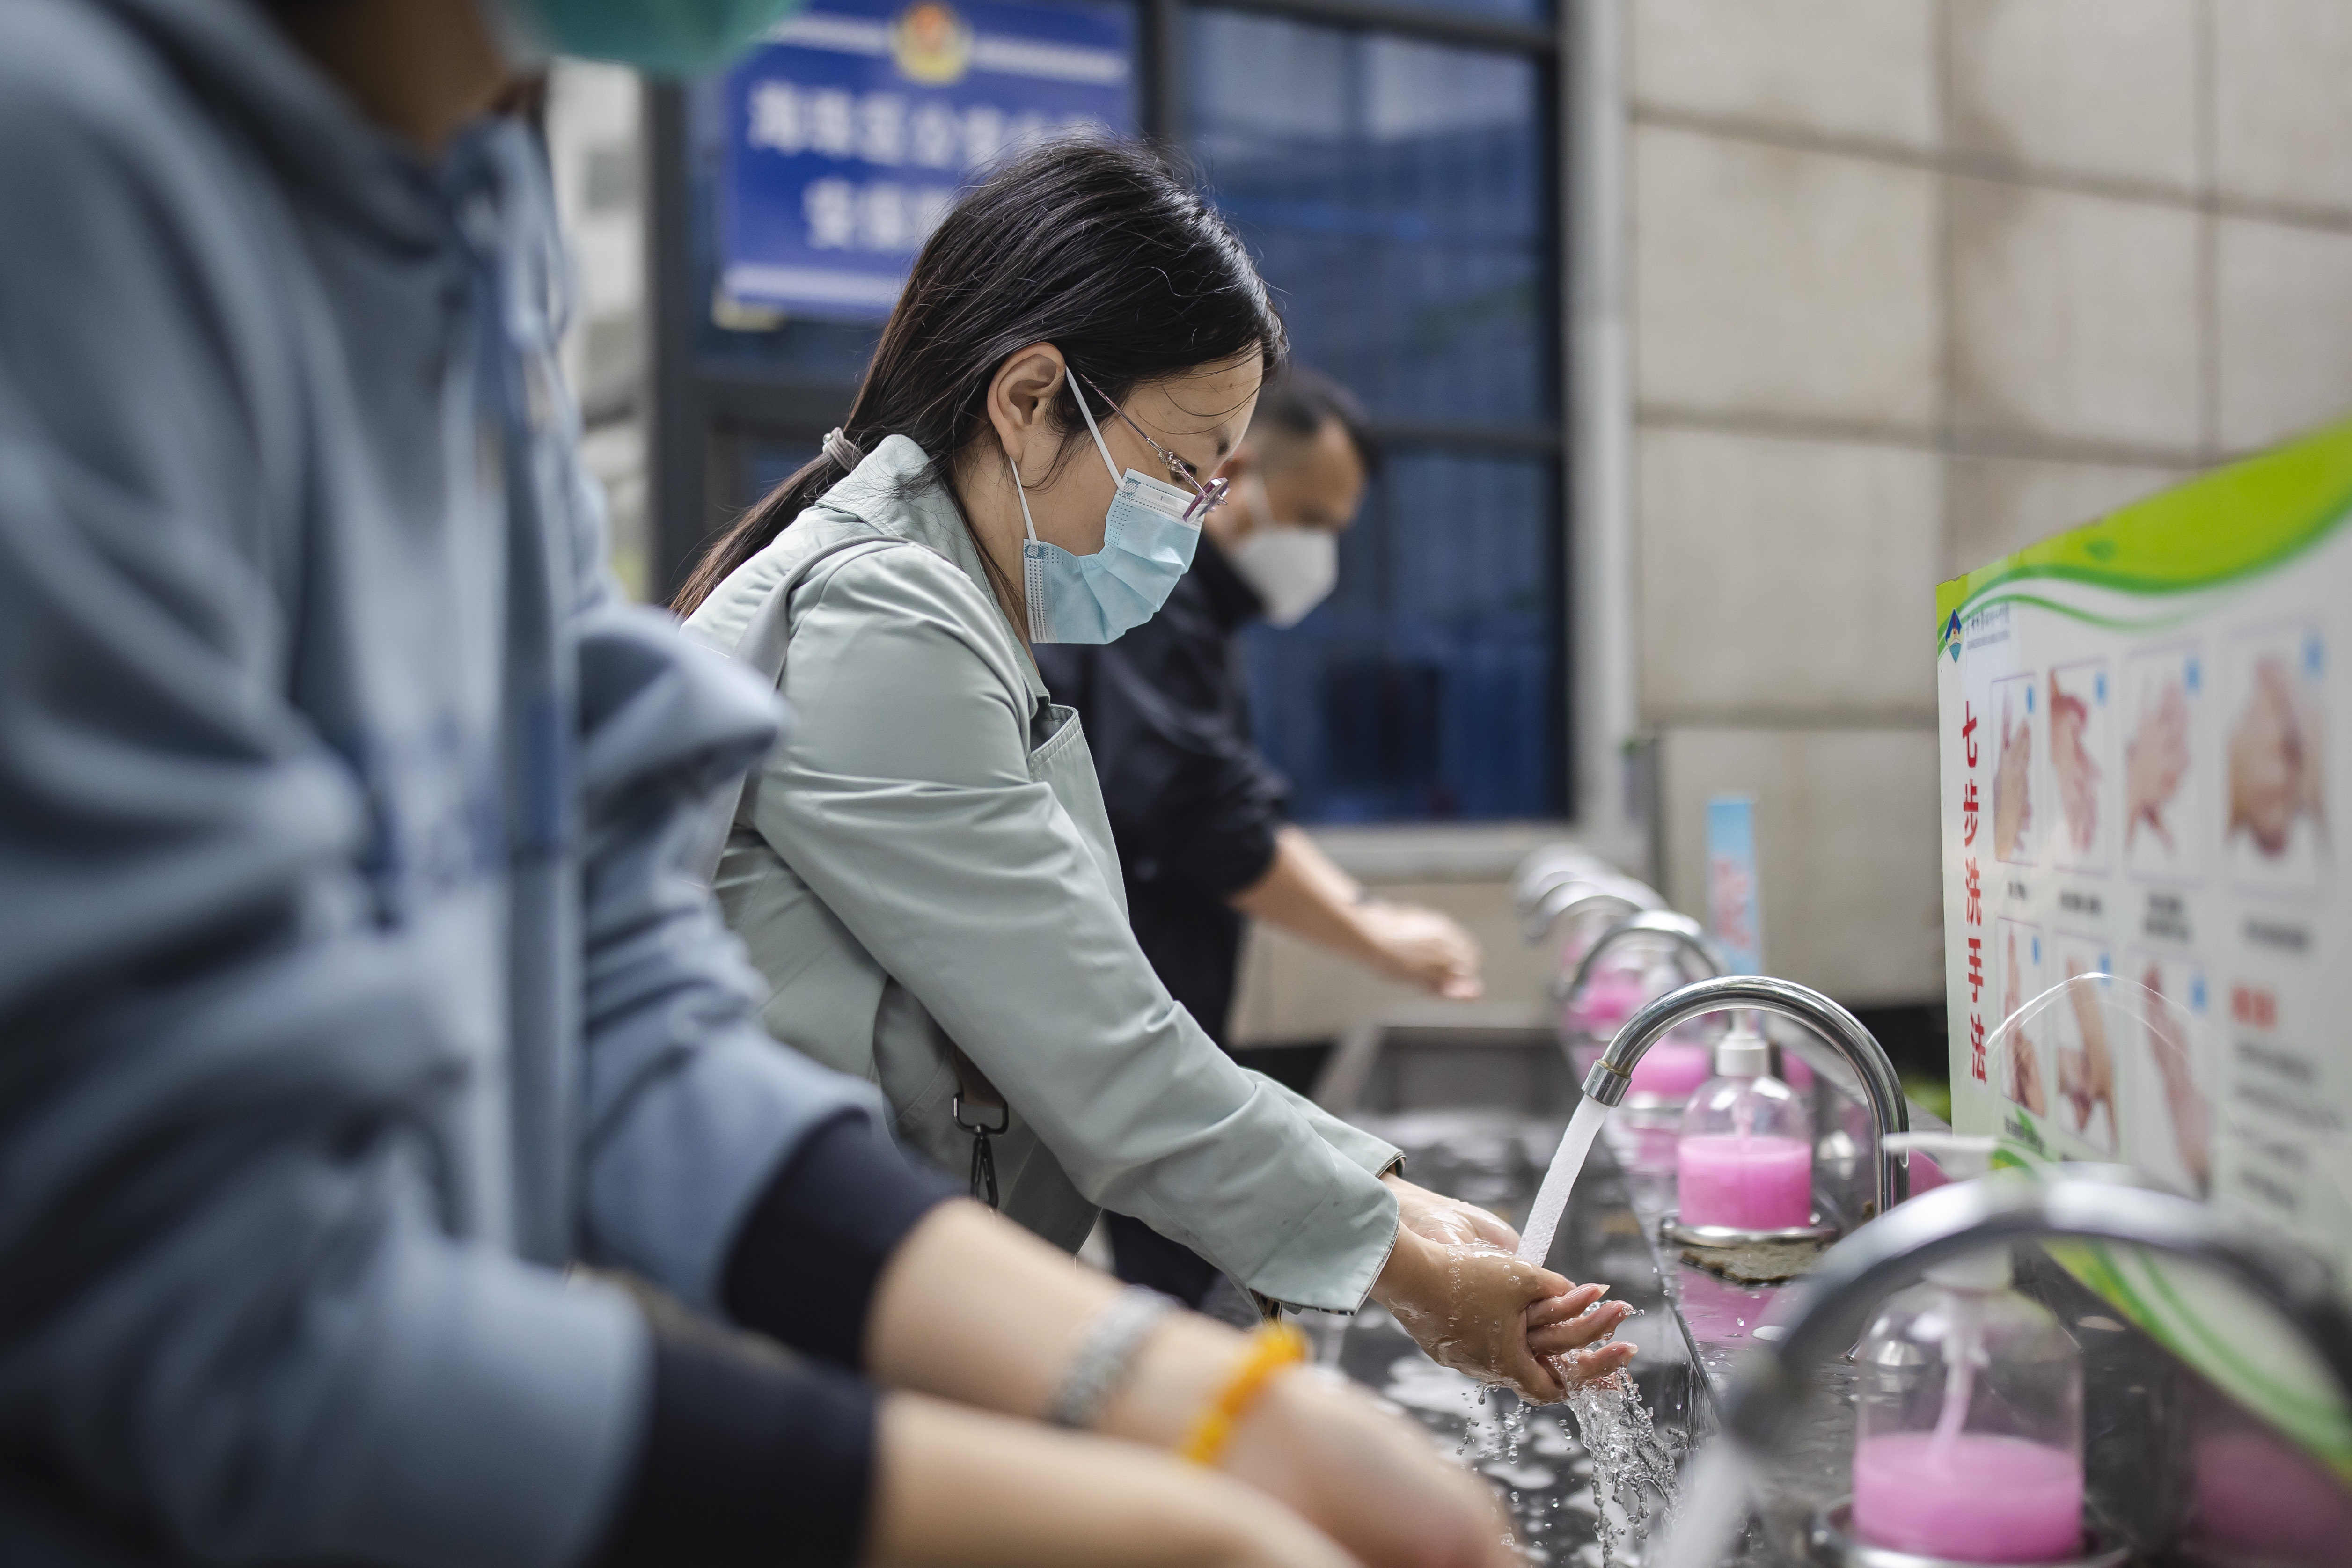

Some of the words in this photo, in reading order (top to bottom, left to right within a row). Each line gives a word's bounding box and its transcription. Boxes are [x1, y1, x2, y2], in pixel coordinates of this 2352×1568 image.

[1963, 700, 1987, 1085] 七步洗手法
